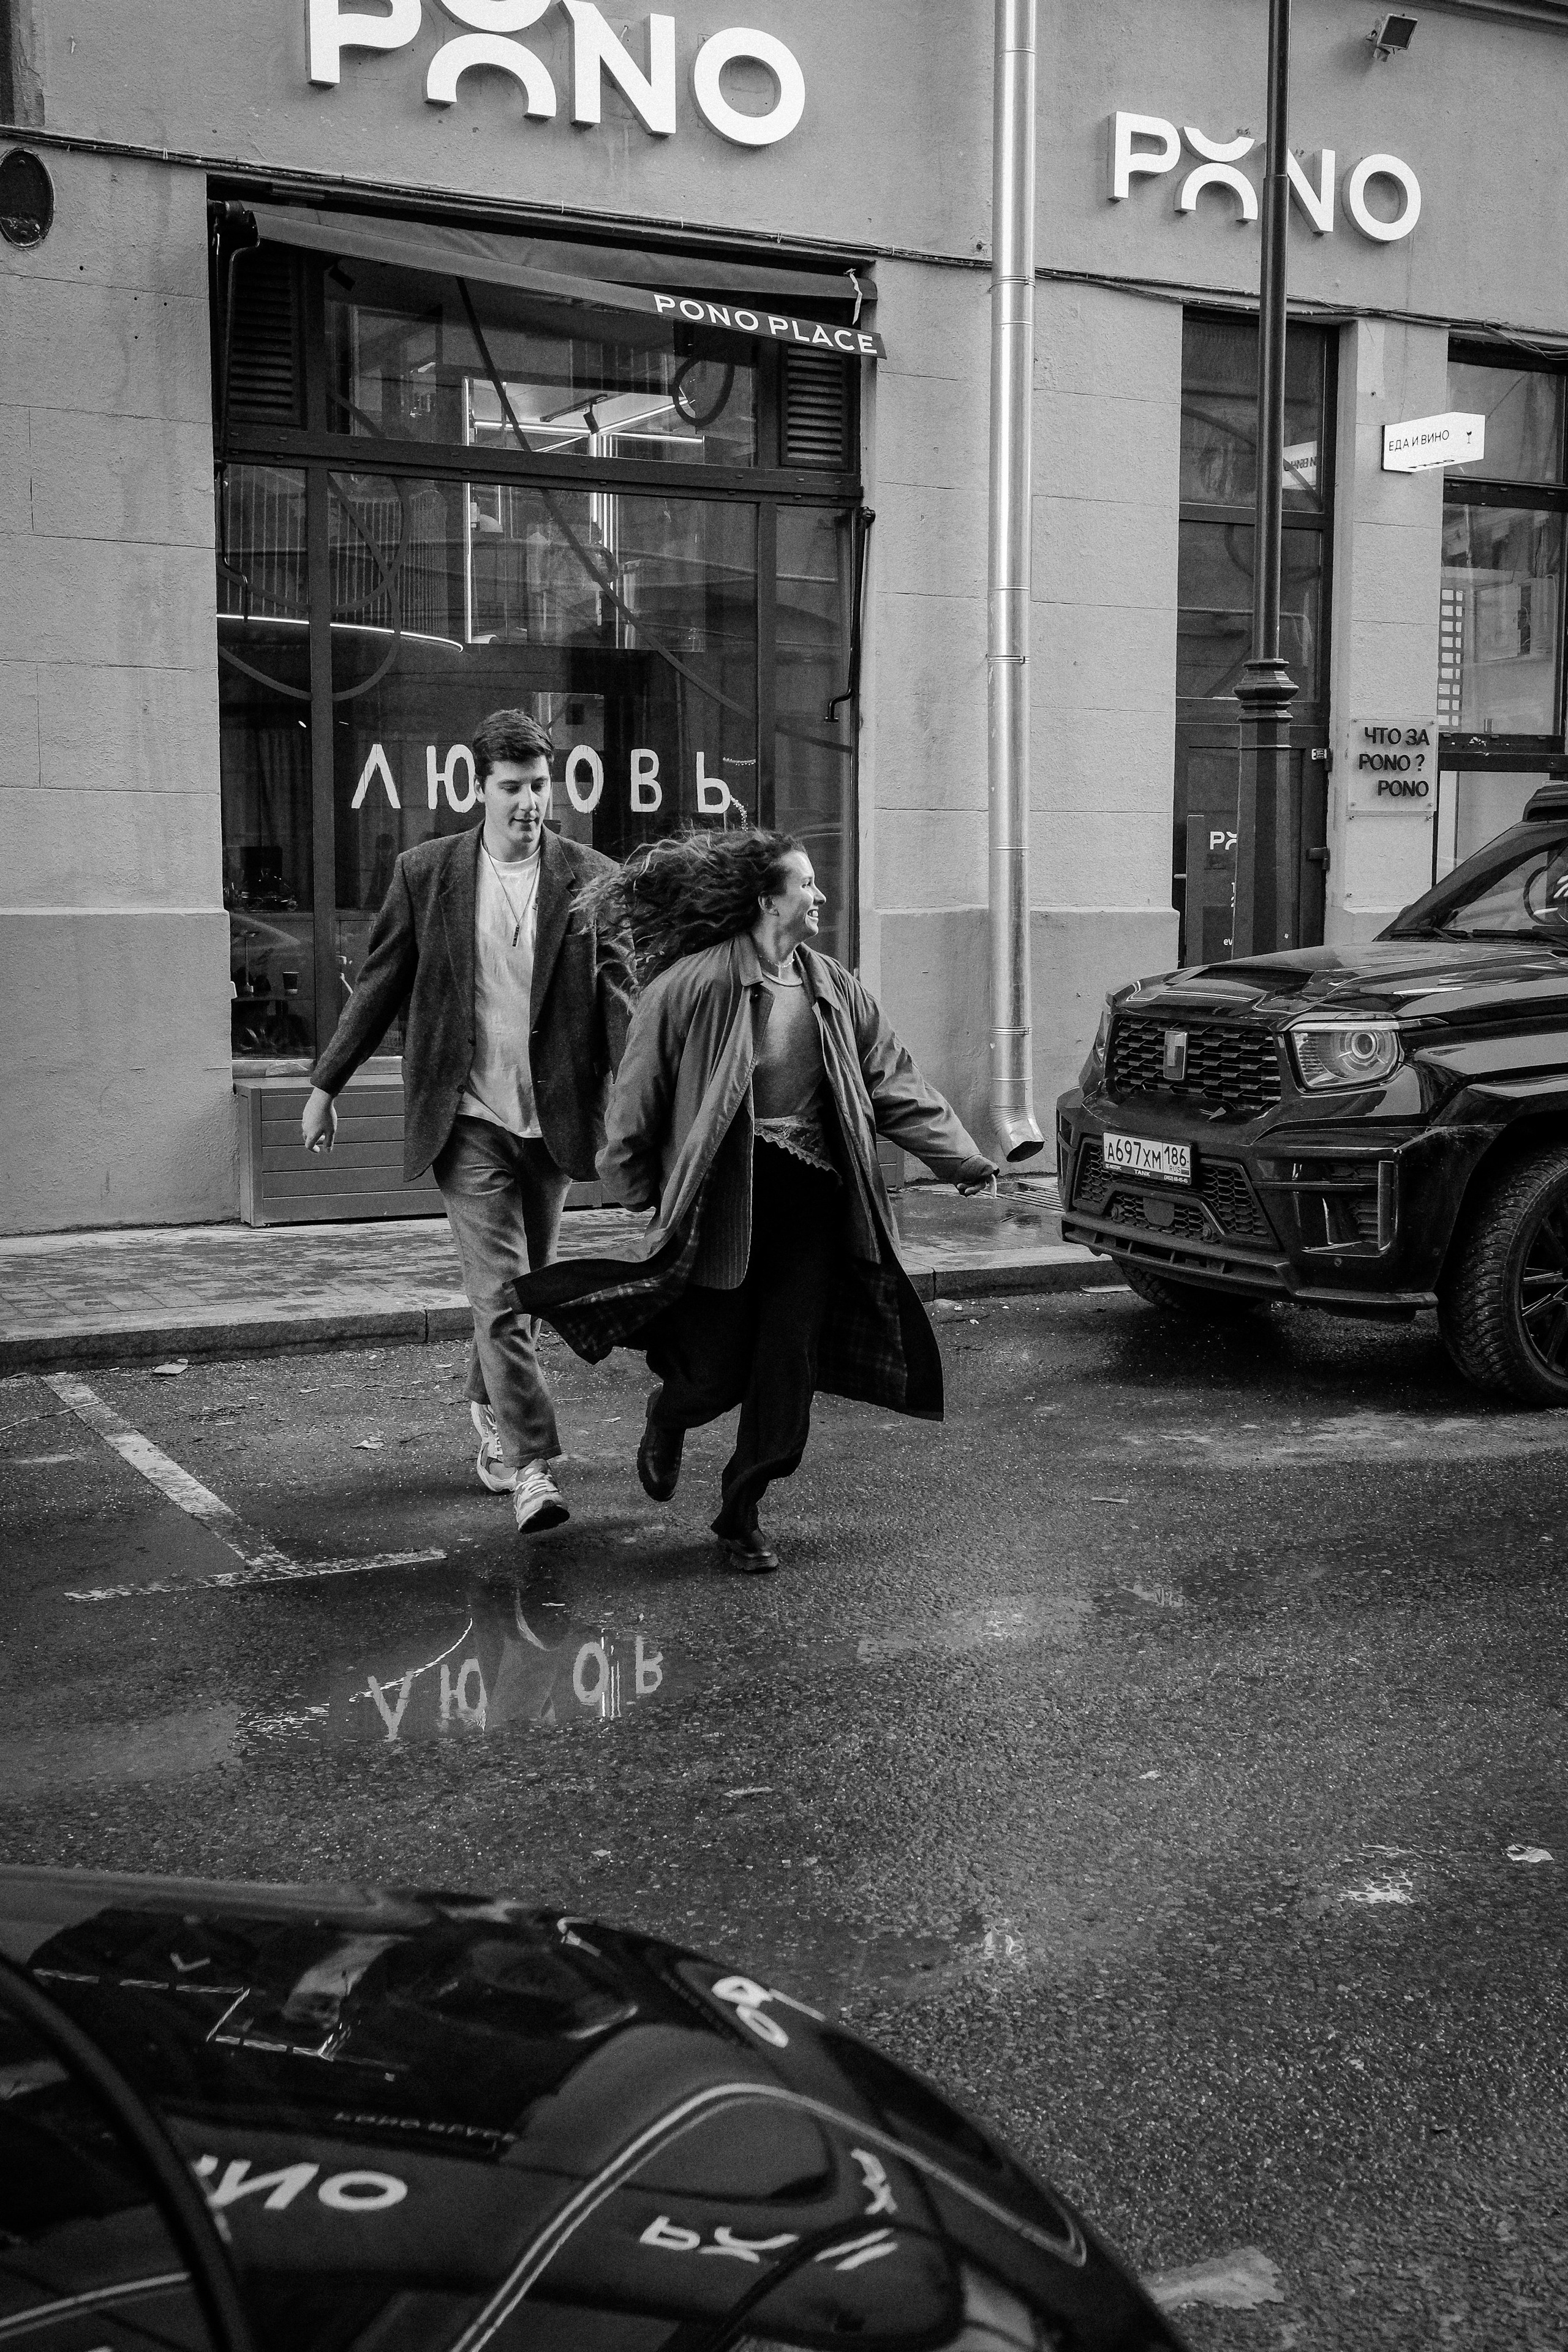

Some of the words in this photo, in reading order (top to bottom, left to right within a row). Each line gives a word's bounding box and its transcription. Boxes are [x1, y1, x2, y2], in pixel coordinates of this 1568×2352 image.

[654, 294, 759, 331] PONO
[767, 315, 878, 354] PLACE
[1389, 439, 1409, 451] ЕДА
[1412, 436, 1419, 447] И
[1421, 430, 1449, 445] ВИНО
[1365, 726, 1401, 744] ЧТО
[1405, 728, 1430, 745] ЗА
[1359, 753, 1411, 771] PONO
[351, 742, 731, 813] ЛЮОВЬ
[1378, 780, 1429, 797] PONO
[1164, 1146, 1186, 1166] 186
